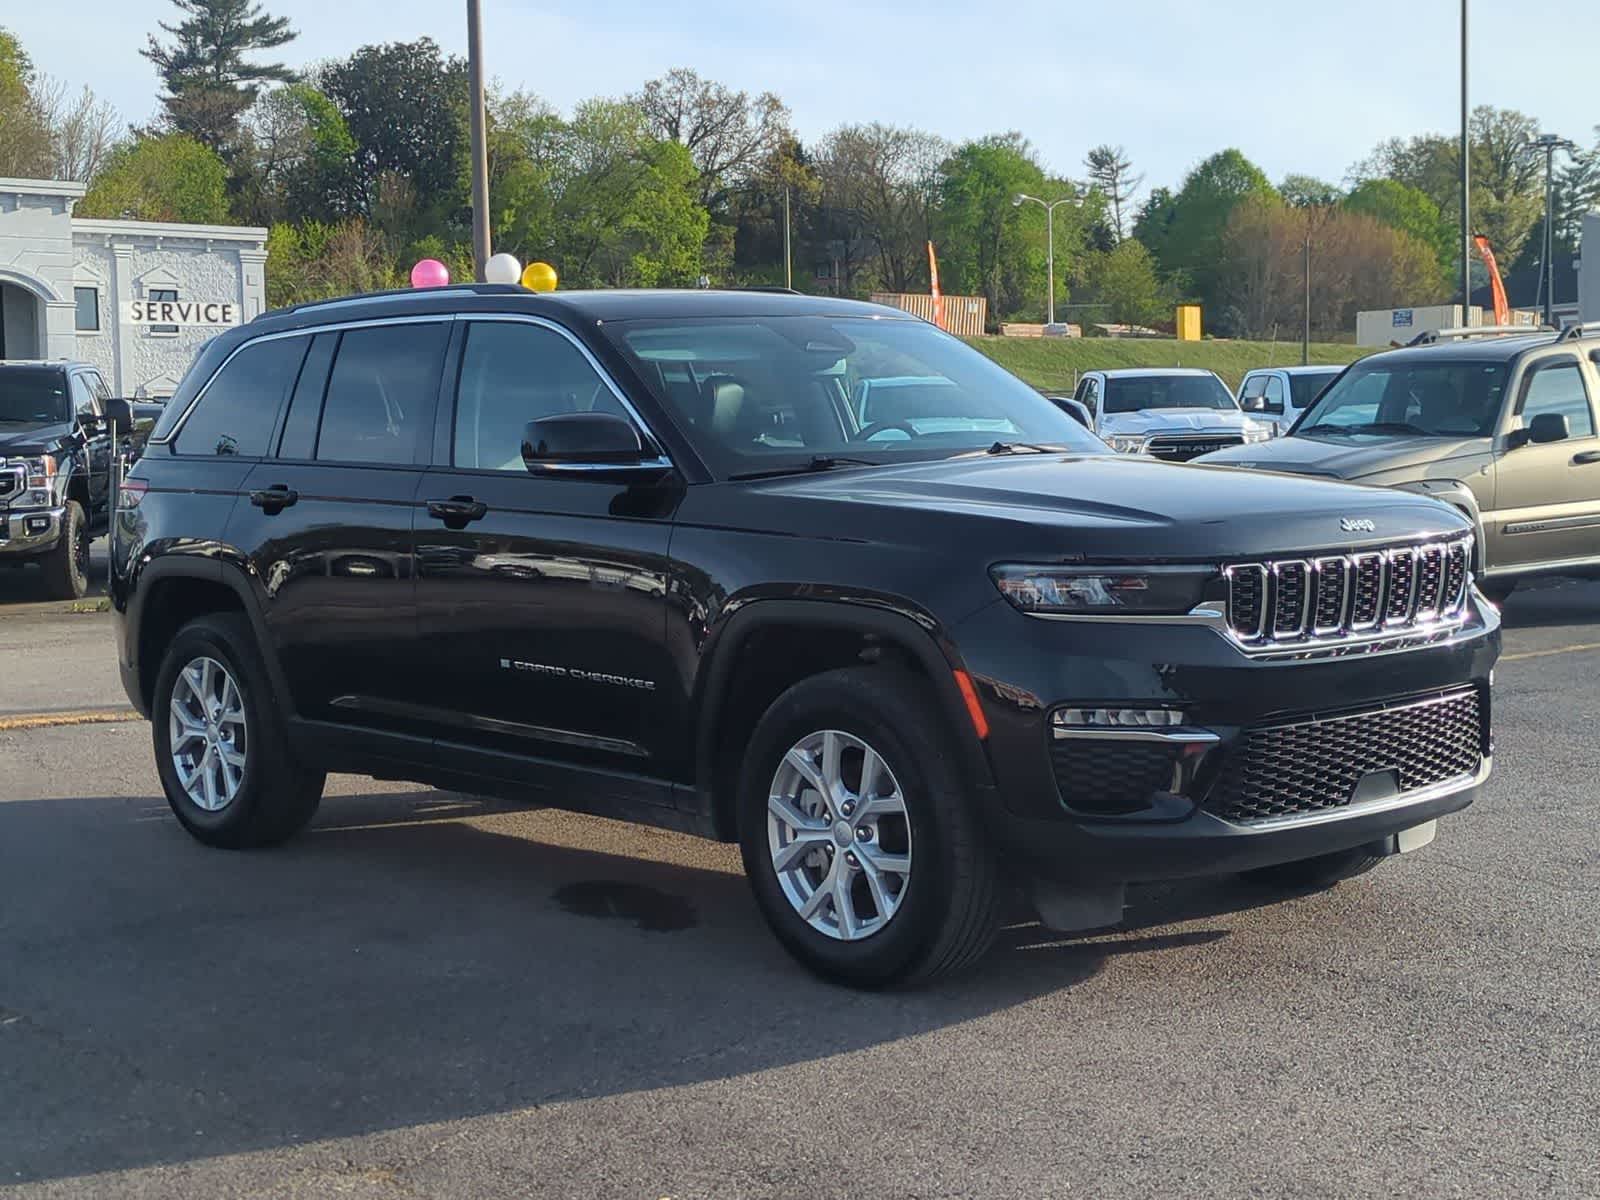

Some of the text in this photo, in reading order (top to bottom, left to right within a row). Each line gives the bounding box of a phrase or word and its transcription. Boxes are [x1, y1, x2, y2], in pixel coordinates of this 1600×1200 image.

[131, 301, 232, 323] SERVICE
[1340, 517, 1375, 532] Jeep
[513, 660, 656, 690] GRAND CHEROKEE
